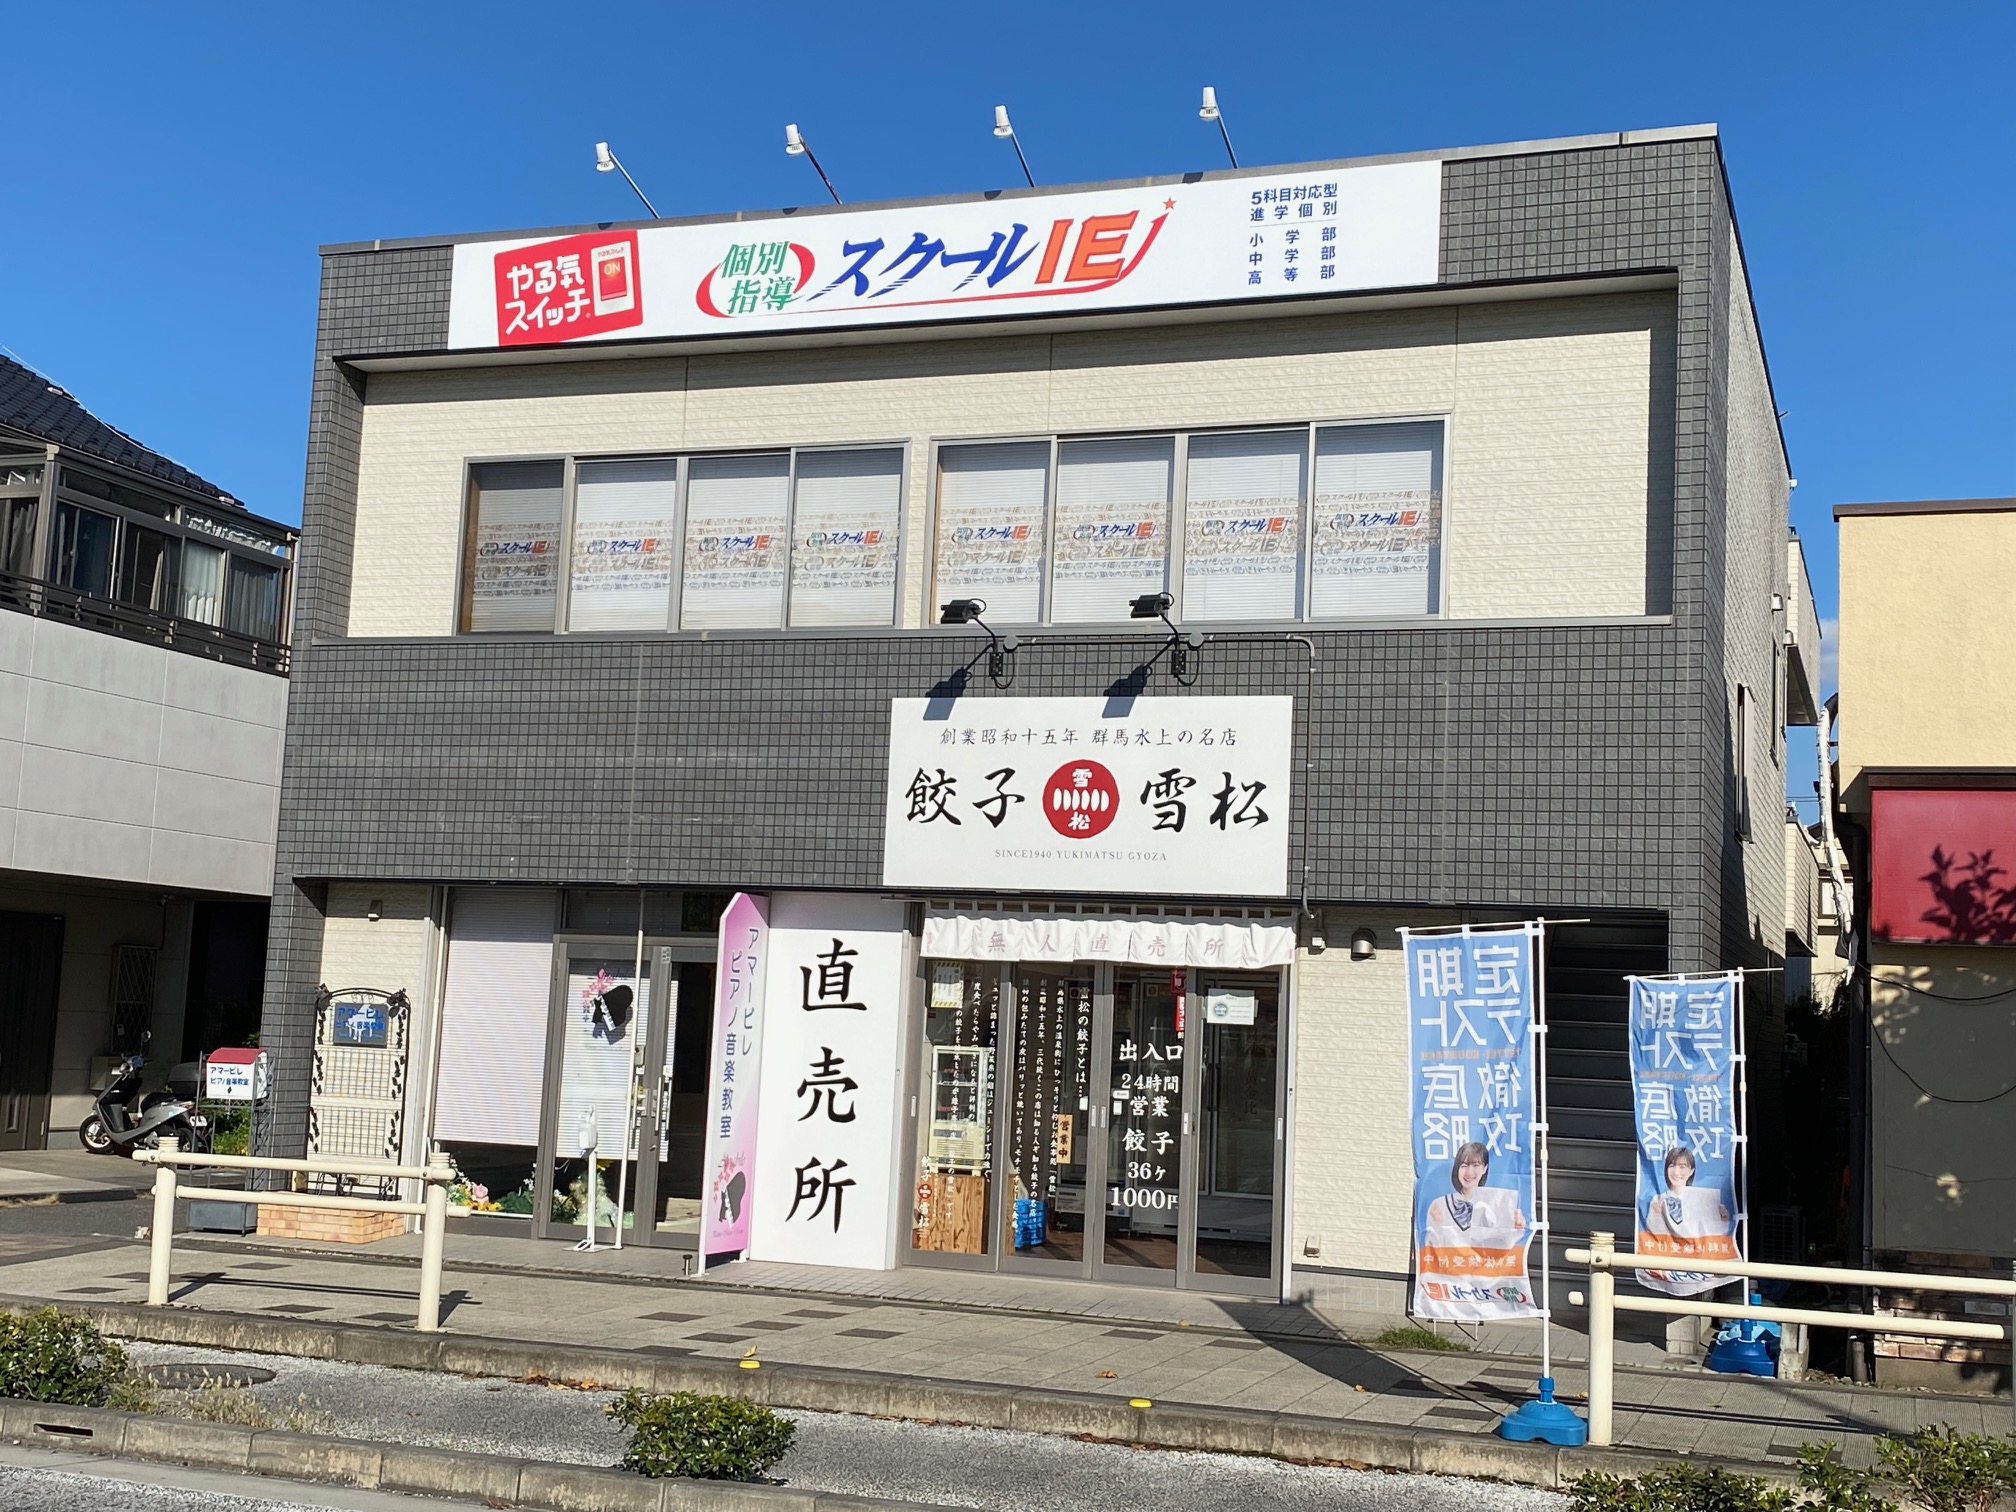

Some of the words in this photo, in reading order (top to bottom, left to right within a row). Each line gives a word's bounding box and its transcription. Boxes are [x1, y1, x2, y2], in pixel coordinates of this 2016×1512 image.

[1251, 183, 1338, 205] 5科目対応型
[1250, 201, 1338, 222] 進学個別
[1249, 226, 1337, 247] 小学部
[721, 241, 790, 278] 個別
[1249, 245, 1336, 267] 中学部
[506, 253, 585, 296] やる気
[604, 261, 621, 276] ON
[1248, 264, 1336, 286] 高等部
[726, 274, 797, 315] 指導
[504, 289, 591, 336] スイッチ
[940, 728, 1079, 746] 創業昭和十五年
[1091, 728, 1237, 747] 群馬水上の名店
[905, 767, 1025, 829] 餃子
[1140, 768, 1270, 833] 雪松
[994, 849, 1052, 859] SINCE1940
[1056, 850, 1124, 861] YUKIMATSU
[1128, 852, 1167, 861] GYOZA
[740, 928, 759, 1056] アマービレ
[720, 951, 745, 1139] ピアノ音楽教室
[1119, 1039, 1183, 1061] 出入口
[210, 1066, 243, 1076] アマービレ
[785, 938, 868, 1234] 直売所
[1121, 1073, 1179, 1093] 24時間
[1130, 1095, 1169, 1117] 営業
[1059, 1120, 1071, 1158] 営業中
[1122, 1128, 1174, 1155] 餃子
[1111, 1187, 1179, 1209] 1000円
